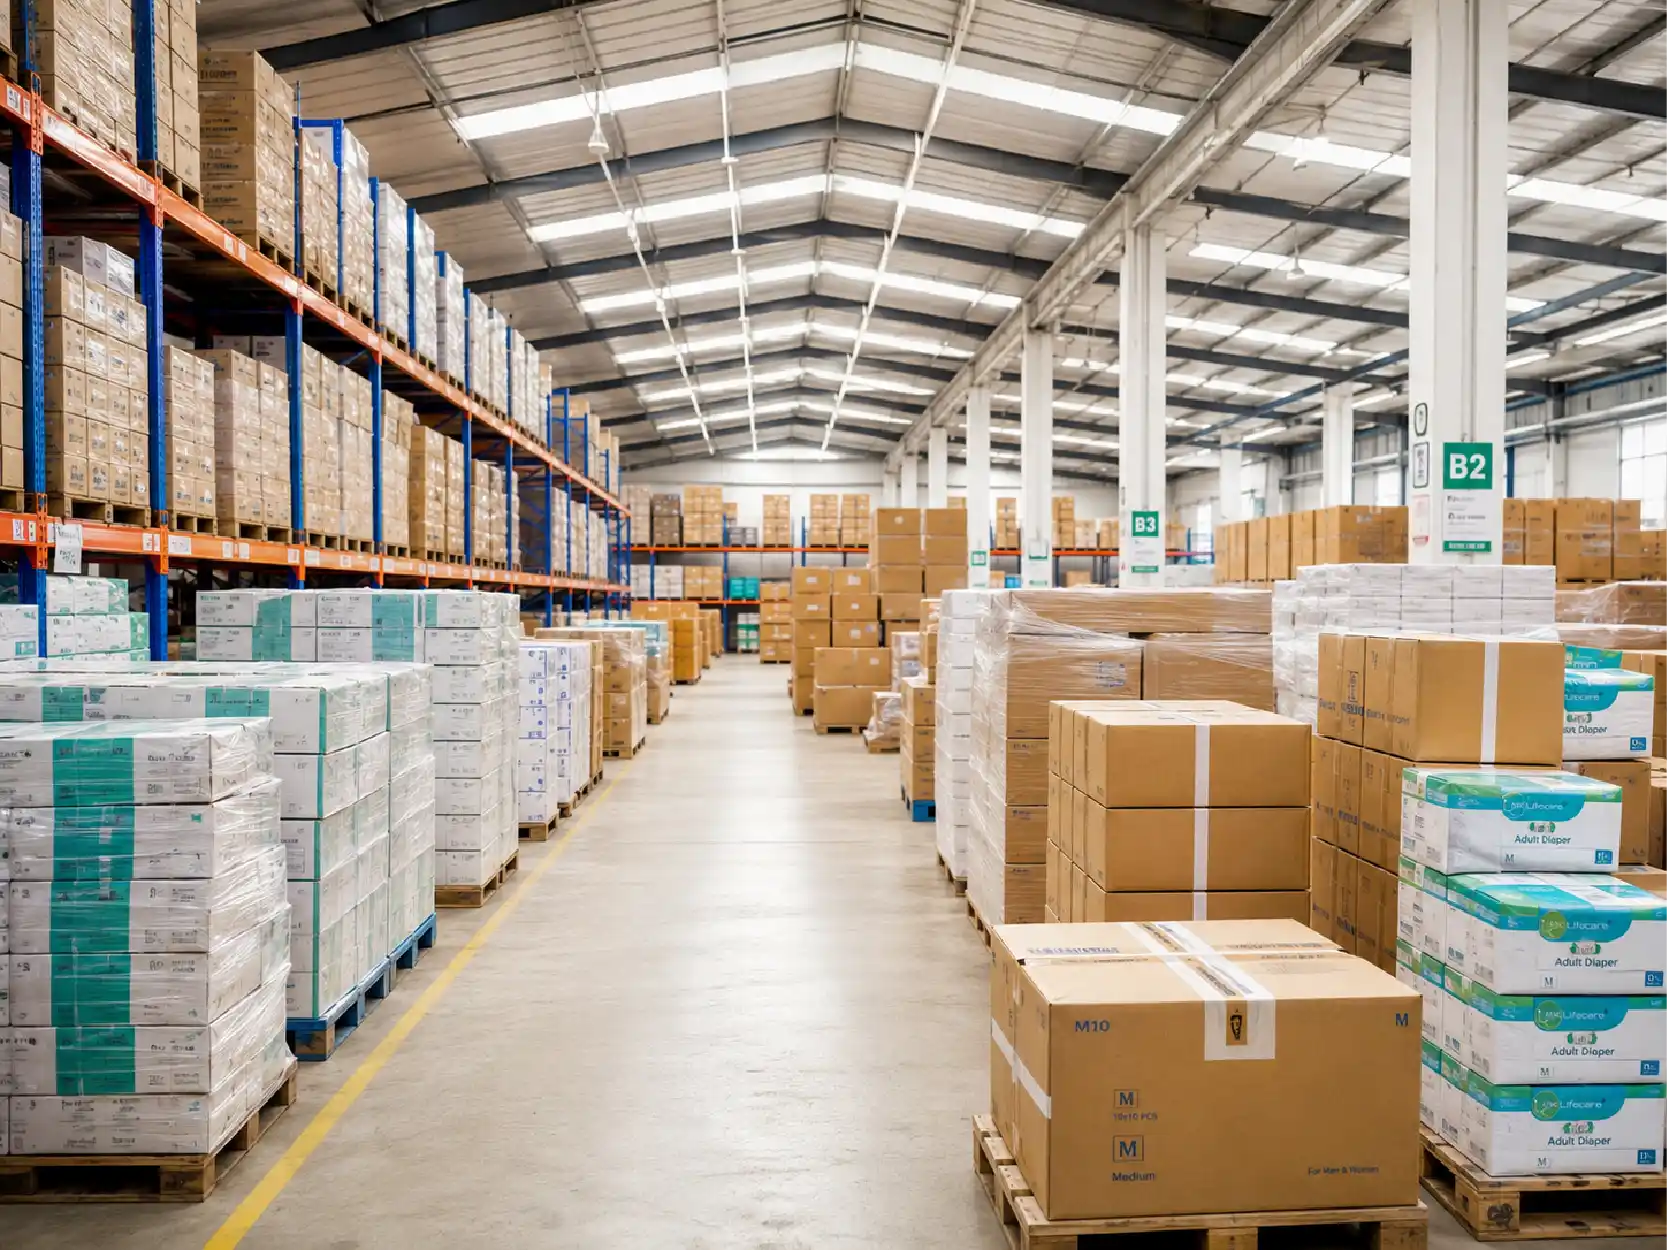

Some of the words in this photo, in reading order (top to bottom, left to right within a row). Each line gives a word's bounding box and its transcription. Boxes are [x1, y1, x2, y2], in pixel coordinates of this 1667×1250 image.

[1449, 453, 1486, 480] B2
[1135, 516, 1156, 533] B3
[1514, 834, 1540, 845] Adult
[1541, 834, 1571, 846] Diaper
[1554, 957, 1582, 968] Adult
[1584, 957, 1618, 969] Diaper
[1544, 976, 1554, 987] M
[1074, 1019, 1110, 1033] M10
[1395, 1013, 1409, 1027] M
[1551, 1046, 1578, 1056] Adult
[1580, 1046, 1615, 1058] Diaper
[1119, 1091, 1134, 1106] M
[1547, 1136, 1575, 1146] Adult
[1577, 1136, 1612, 1148] Diaper
[1119, 1140, 1137, 1158] M
[1112, 1171, 1155, 1182] Medium
